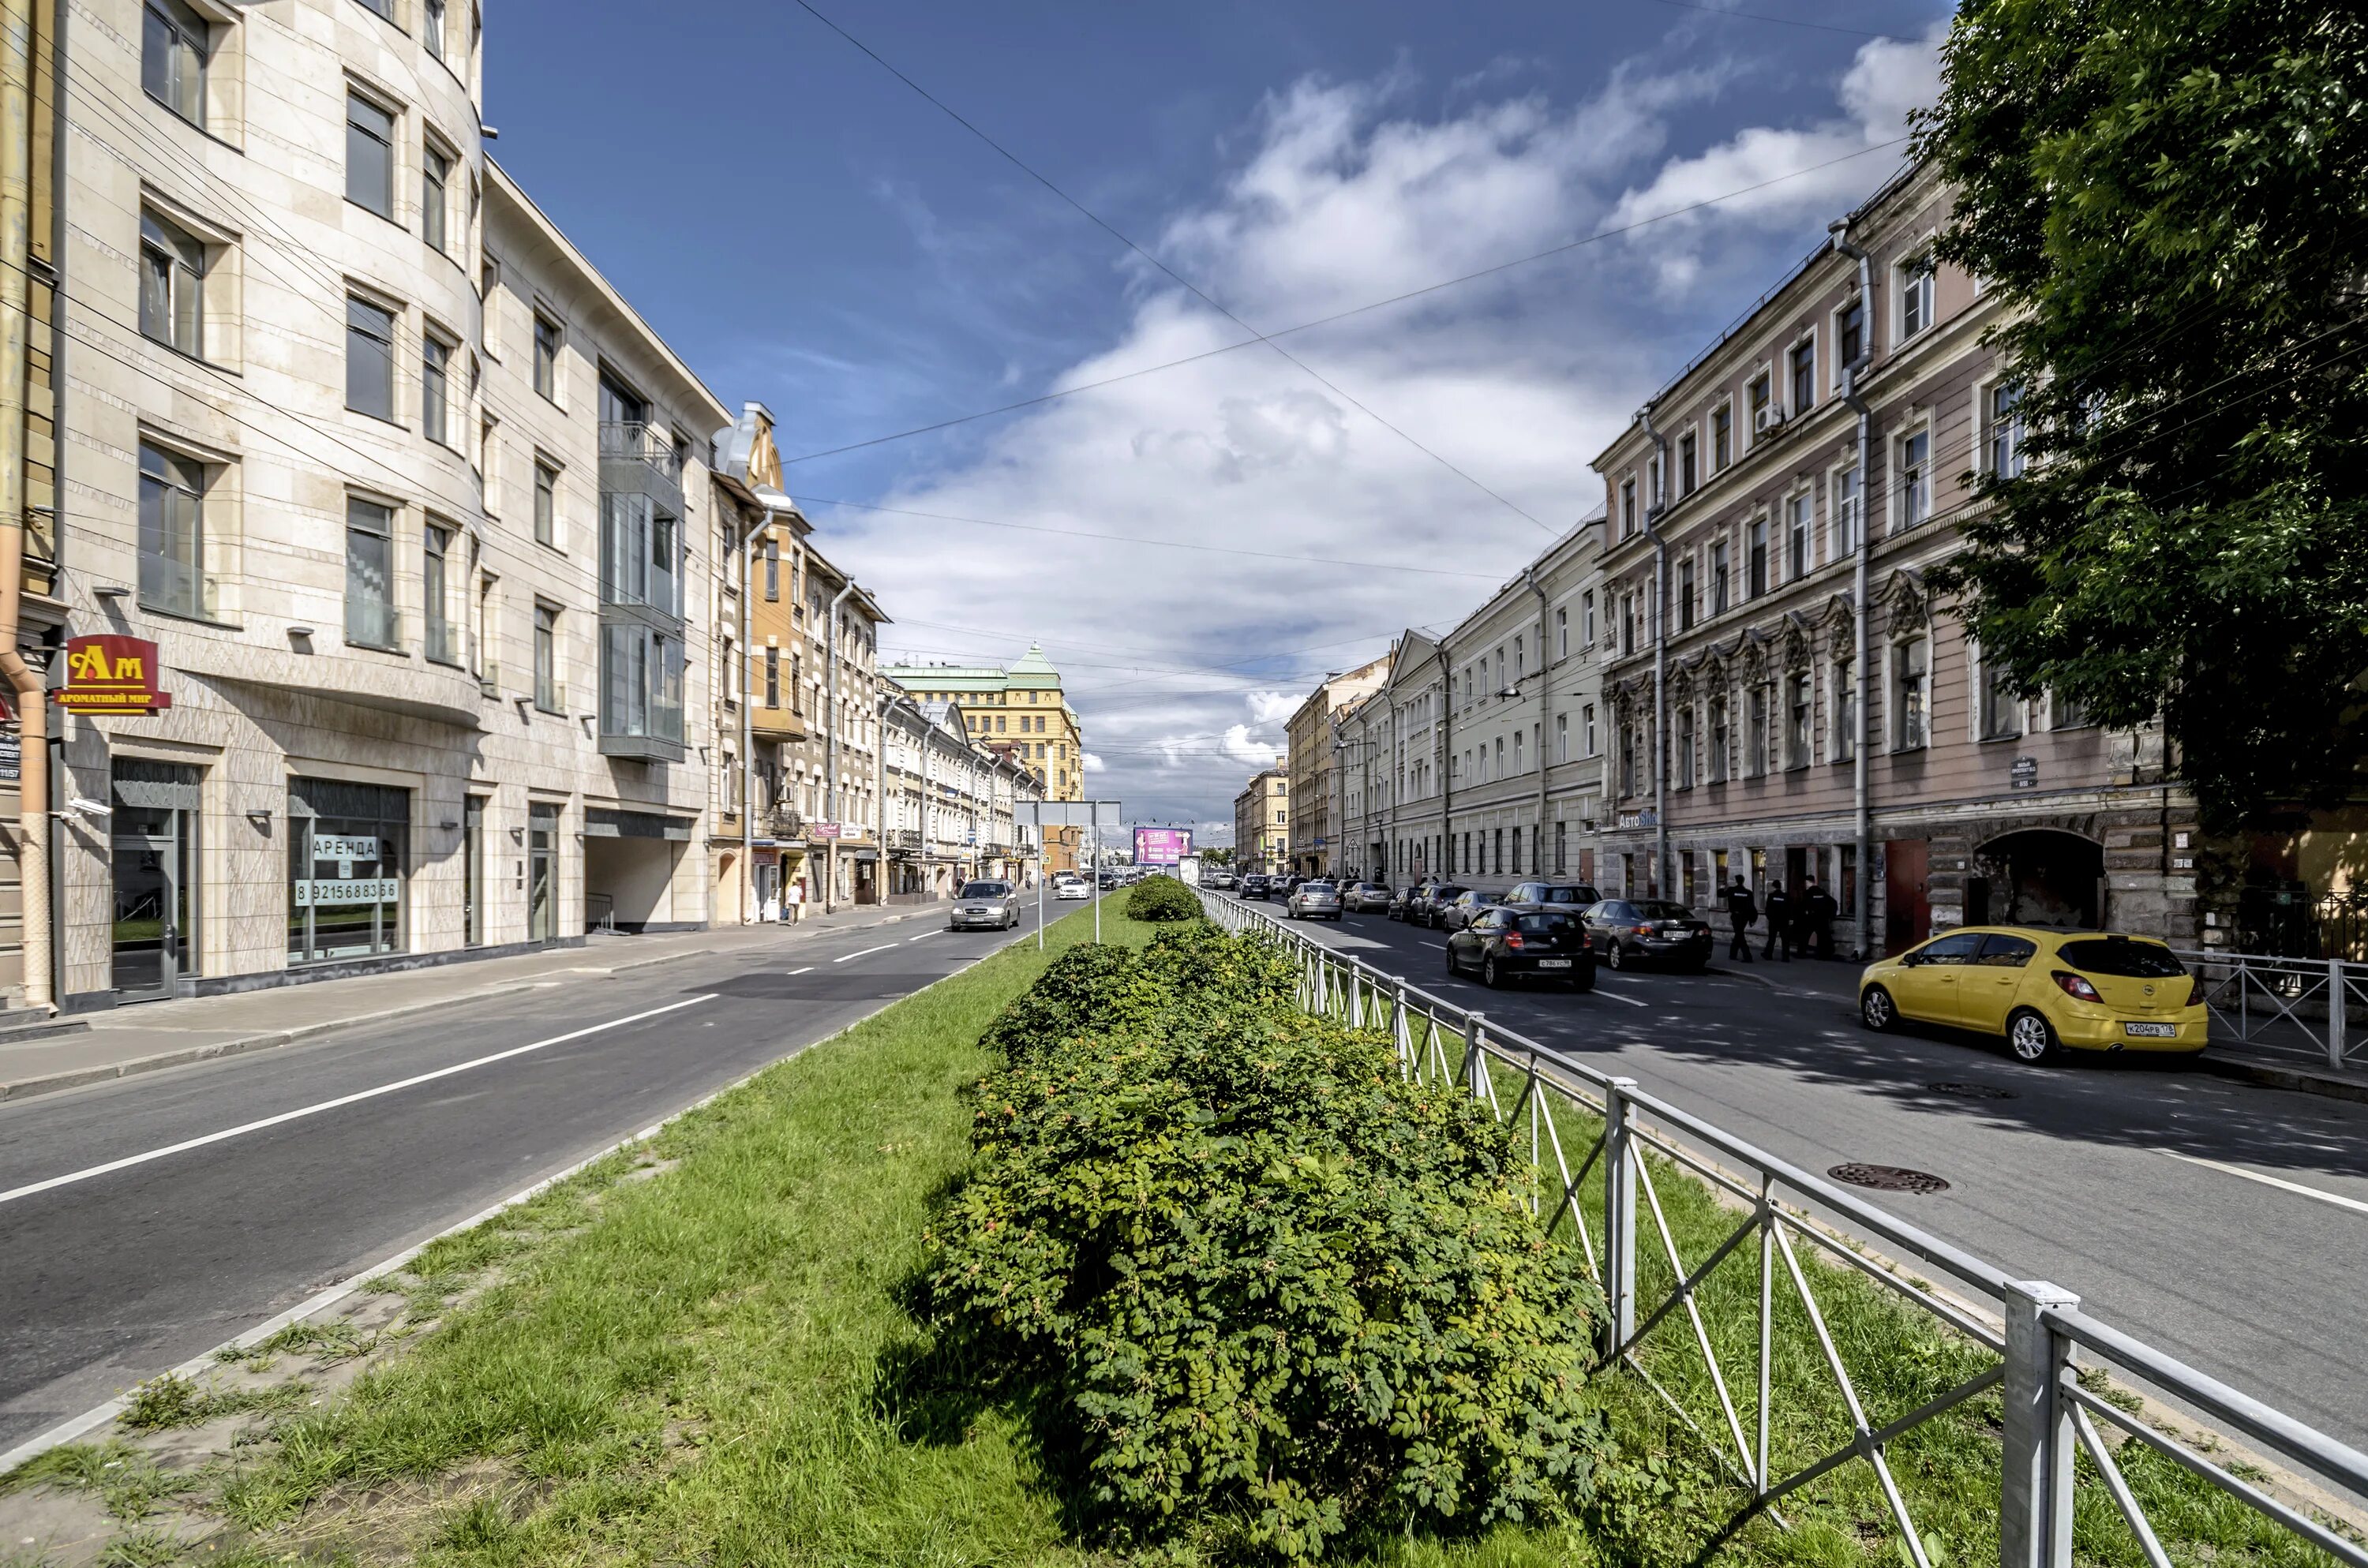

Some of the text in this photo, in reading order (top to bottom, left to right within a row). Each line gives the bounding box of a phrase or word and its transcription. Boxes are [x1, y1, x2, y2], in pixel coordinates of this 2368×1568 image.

[69, 645, 144, 679] Ам
[58, 693, 152, 703] АРОМАТНЫЙ МИР
[0, 750, 20, 758] СПЕКТ
[1619, 808, 1657, 829] АвтоSho
[313, 840, 375, 858] АРЕНДА
